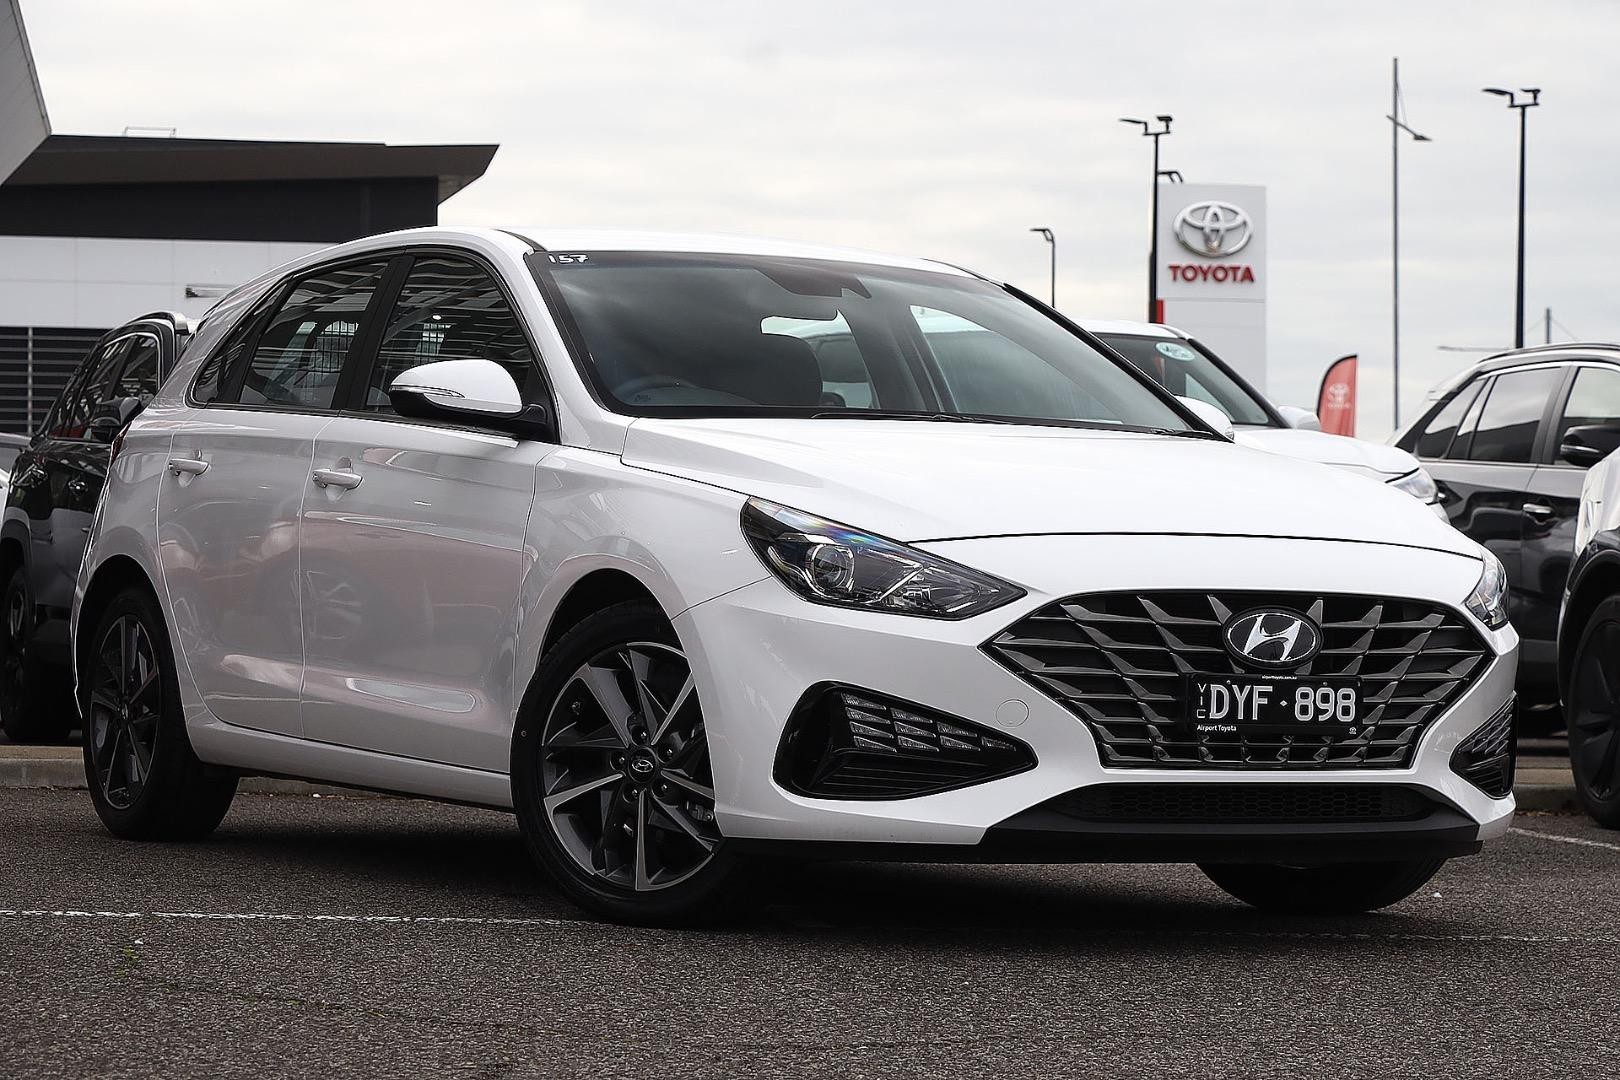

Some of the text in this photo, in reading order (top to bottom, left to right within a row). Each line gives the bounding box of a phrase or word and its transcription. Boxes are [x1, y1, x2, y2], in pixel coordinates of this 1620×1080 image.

[1168, 265, 1255, 283] TOYOTA
[1197, 683, 1207, 719] VIC
[1209, 684, 1356, 722] DYF 898
[1197, 724, 1237, 732] Airport Toyota
